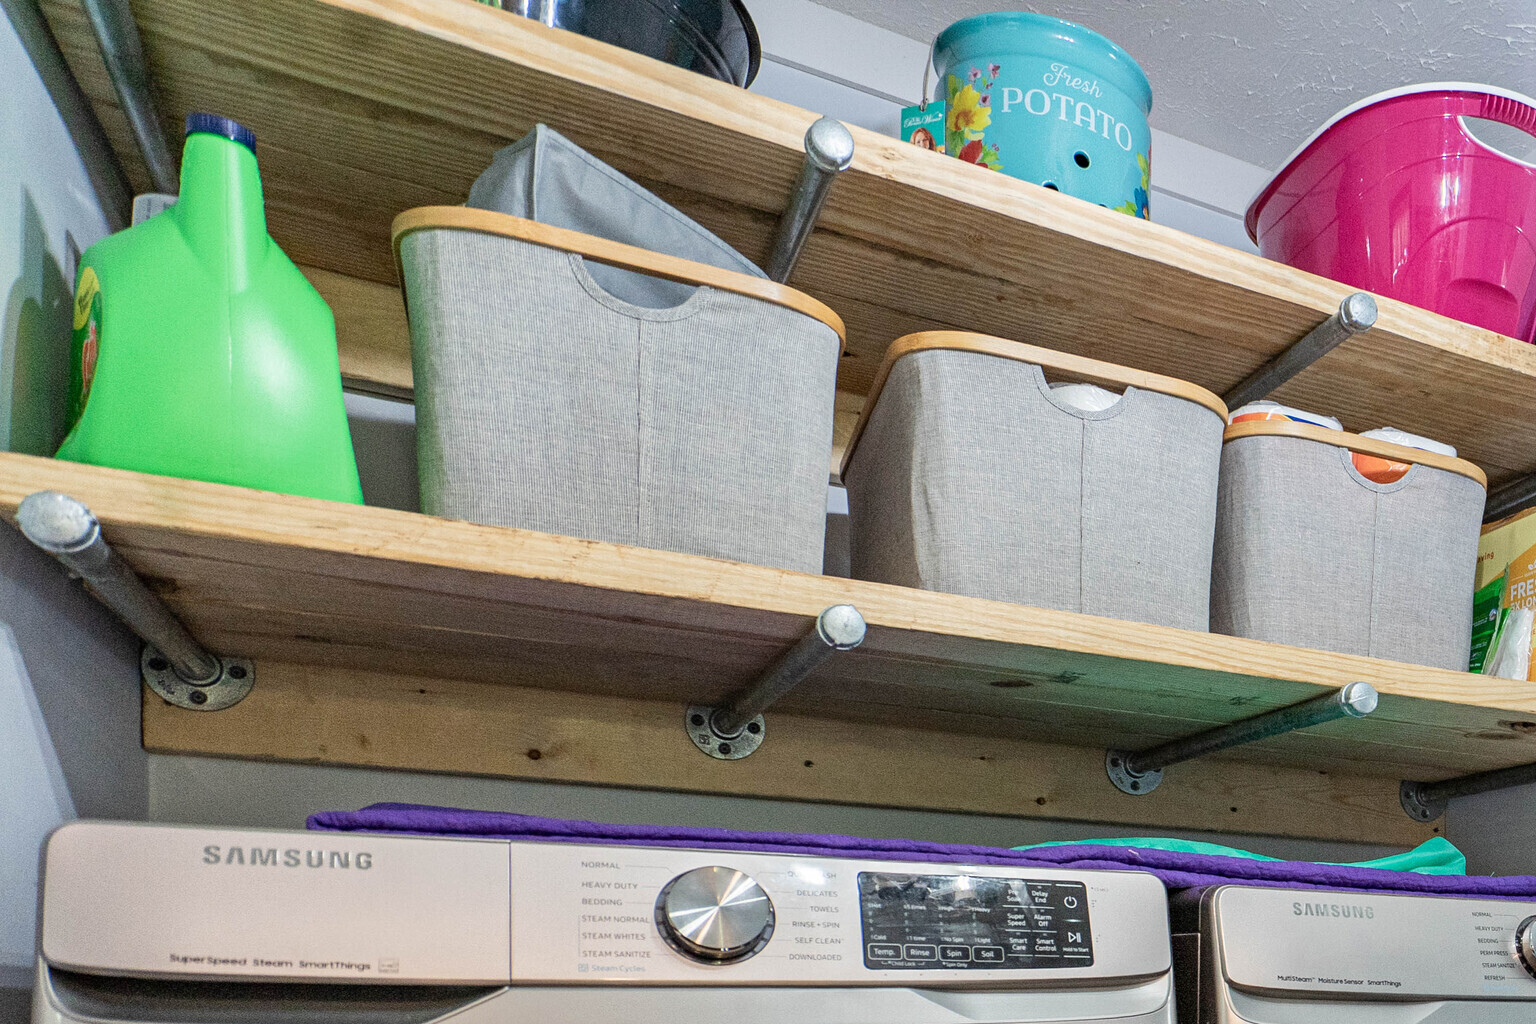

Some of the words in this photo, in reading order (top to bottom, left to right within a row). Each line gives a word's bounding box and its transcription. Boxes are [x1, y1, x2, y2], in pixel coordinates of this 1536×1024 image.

[1043, 62, 1103, 98] Fresh
[1001, 87, 1132, 151] POTATO
[202, 844, 373, 872] SAMSUNG
[581, 861, 621, 870] NORMAL
[581, 881, 612, 890] HEAVY
[614, 882, 638, 890] DUTY
[796, 889, 838, 897] DELICATES
[581, 898, 623, 906] BEDDING
[810, 905, 839, 913] TOWELS
[1293, 902, 1374, 920] SAMSUNG
[582, 915, 609, 923] STEAM
[610, 916, 650, 924] NORMAL
[1007, 919, 1026, 927] Speed
[792, 920, 815, 928] RINSE
[822, 921, 840, 929] SPIN
[582, 932, 609, 940] STEAM
[610, 933, 646, 941] WHITES
[794, 936, 814, 944] SELF
[582, 950, 609, 958] STEAM
[611, 950, 651, 959] SANITIZE
[874, 948, 896, 956] Temp.
[910, 949, 930, 957] Rinse
[946, 949, 962, 958] Spin
[981, 950, 994, 958] Soil
[789, 953, 842, 961] DOWNLOADED
[253, 959, 292, 968] Steam
[299, 959, 371, 972] SmartThings
[1318, 976, 1343, 985] Moisture
[1344, 977, 1364, 985] Sensor
[1367, 979, 1402, 988] SmartThings
